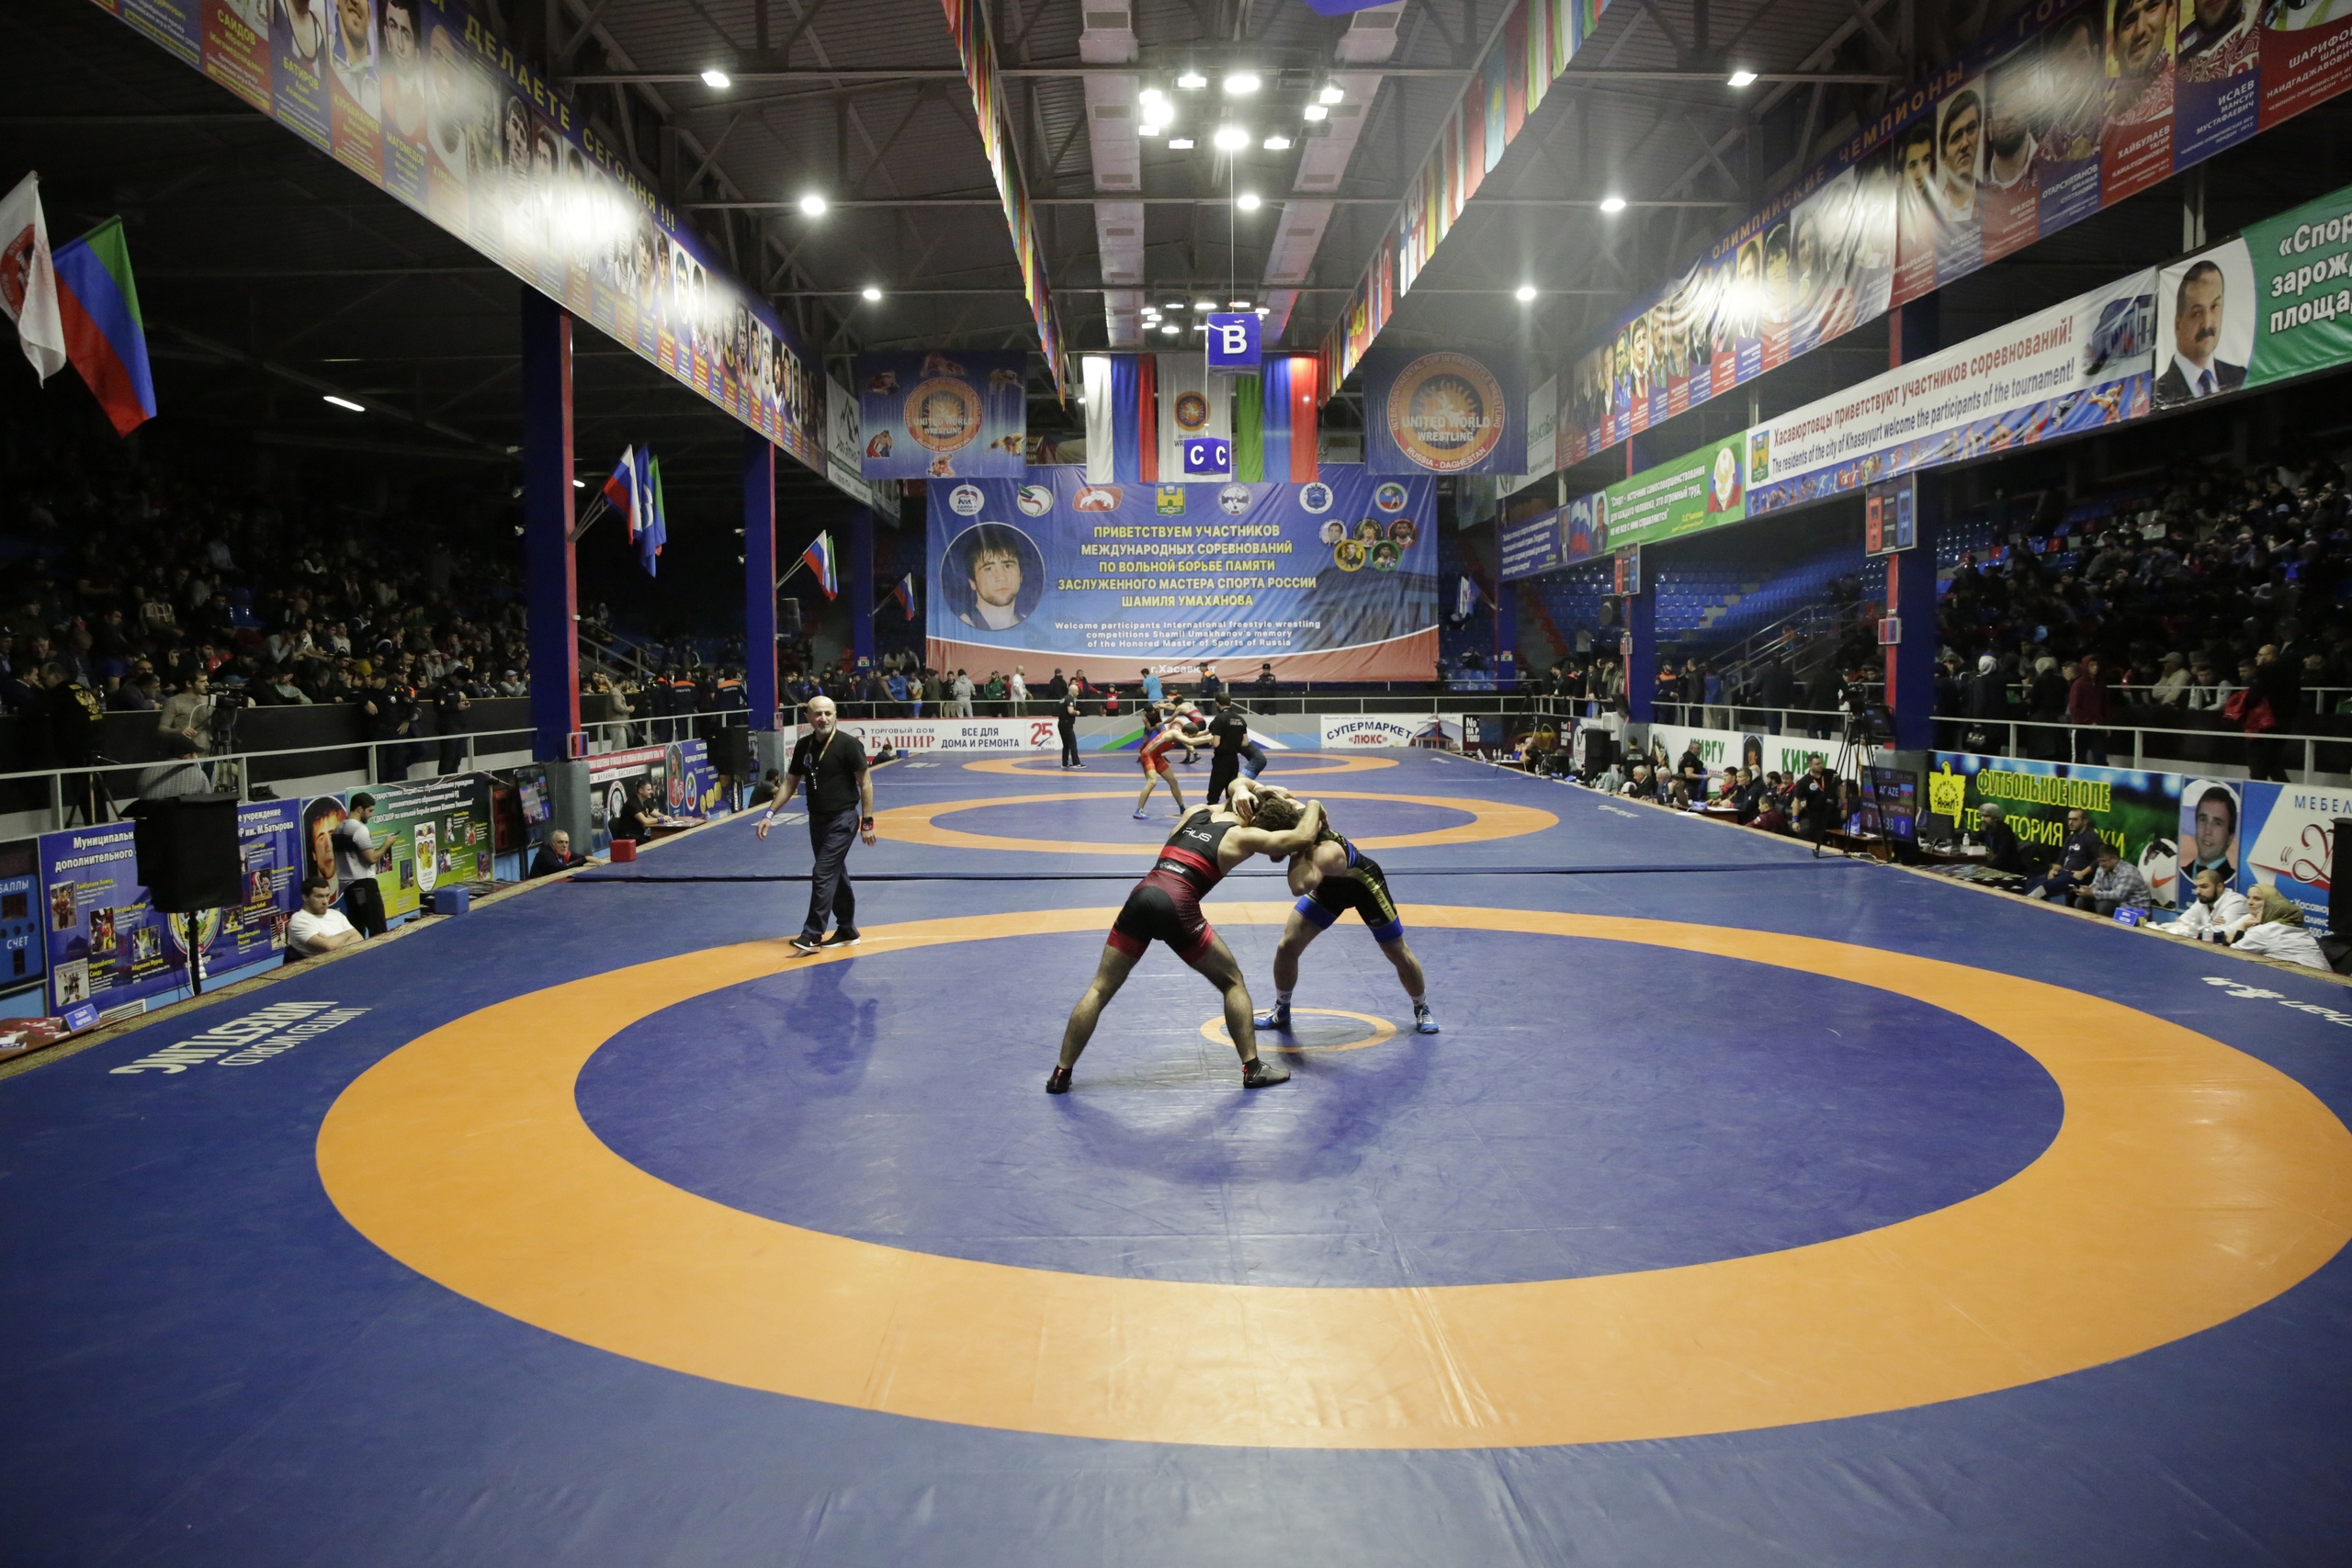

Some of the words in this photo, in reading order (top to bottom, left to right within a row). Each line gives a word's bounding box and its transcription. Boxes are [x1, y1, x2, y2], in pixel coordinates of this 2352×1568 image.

[218, 9, 256, 46] САИДОВ
[283, 56, 319, 90] БАТИРОВ
[2218, 79, 2255, 106] ИСАЕВ
[2221, 91, 2255, 114] МАНСУР
[465, 14, 571, 131] ДЕЛАЕТЕ
[582, 128, 656, 213] СЕГОДНЯ
[2197, 100, 2255, 135] МУСТАФАЕВИЧ
[2118, 125, 2170, 159] ХАЙБУЛАЕВ
[2150, 135, 2170, 151] ТАГИР
[1712, 166, 1825, 260] ОЛИМПИЙСКИЕ
[1838, 61, 1963, 163] ЧЕМПИОНЫ
[2009, 197, 2036, 216] МАХОВ
[1773, 411, 1833, 447] Хасавюртовцы
[1834, 385, 1899, 429] приветствуют
[1902, 362, 1967, 406] участников
[1970, 315, 2073, 378] соревнований!
[1389, 363, 1424, 431] INTERCONTINENTAL
[1423, 355, 1441, 367] CUP
[1452, 355, 1490, 385] FREESTYLE
[1487, 380, 1501, 430] WRESTLING
[914, 417, 943, 426] UNITED
[944, 417, 974, 426] WORLD
[1401, 416, 1446, 428] UNITED
[1449, 416, 1490, 428] WORLD
[1772, 457, 1782, 474] The
[1782, 449, 1808, 468] residents
[1808, 446, 1815, 461] of
[1815, 444, 1825, 459] the
[1826, 440, 1837, 459] city
[1838, 434, 1845, 452] of
[1845, 423, 1883, 452] Khasavyurt
[1883, 416, 1916, 438] welcome
[1917, 408, 1930, 428] the
[1930, 391, 1981, 429] participants
[1983, 383, 1993, 405] of
[1994, 381, 2009, 404] the
[2011, 356, 2075, 396] tournament!
[924, 427, 962, 435] WRESTLING
[1417, 432, 1475, 442] WRESTLING
[916, 437, 935, 451] RUSSIA
[939, 437, 971, 452] DAGHESTAN
[1406, 446, 1434, 468] RUSSIA
[1440, 447, 1487, 469] DAGHESTAN
[1093, 525, 1192, 538] ПРИВЕТСТВУЕМ
[1195, 525, 1280, 537] УЧАСТНИКОВ
[1081, 543, 1194, 557] МЕЖДУНАРОДНЫХ
[1197, 540, 1293, 555] СОРЕВНОВАНИЙ
[1099, 561, 1115, 572] ПО
[1119, 559, 1175, 572] ВОЛЬНОЙ
[1178, 559, 1222, 572] БОРЬБЕ
[1225, 559, 1275, 571] ПАМЯТИ
[1058, 578, 1156, 591] ЗАСЛУЖЕННОГО
[1159, 577, 1215, 590] МАСТЕРА
[1217, 577, 1264, 590] СПОРТА
[1267, 576, 1317, 589] РОССИИ
[1121, 594, 1175, 607] ШАМИЛЯ
[1178, 594, 1253, 606] УМАХАНОВА
[1055, 621, 1098, 630] Welcome
[1101, 621, 1160, 631] participants
[1163, 621, 1227, 629] International
[1229, 620, 1272, 630] freestyle
[1275, 620, 1321, 629] wrestling
[1086, 630, 1149, 640] competitions
[1188, 629, 1250, 637] Umakhanov's
[1254, 630, 1293, 638] memory
[1088, 639, 1098, 648] of
[1100, 639, 1116, 648] the
[1119, 639, 1159, 648] Honored
[1162, 638, 1197, 647] Master
[1199, 638, 1210, 647] of
[1212, 638, 1244, 648] Sports
[1246, 638, 1257, 647] of
[1259, 637, 1292, 647] Russia
[961, 728, 978, 737] ВСЕ
[979, 728, 999, 738] ДЛЯ
[1030, 722, 1054, 747] 25
[1327, 721, 1413, 740] СУПЕРМАРКЕТ
[871, 735, 935, 749] БАШИР
[942, 739, 967, 750] ДОМА
[970, 739, 976, 748] И
[977, 738, 1020, 748] РЕМОНТА
[1349, 734, 1387, 745] «ЛЮКС»
[1976, 768, 2068, 807] ФУТБОЛЬНОЕ
[2068, 780, 2111, 813] ПОЛЕ
[243, 807, 281, 823] учреждение
[244, 828, 256, 837] им.
[257, 820, 294, 835] М.Батырова
[1182, 826, 1213, 843] RUS
[74, 830, 134, 851] Муниципальн
[55, 848, 133, 873] дополнительного
[6, 935, 28, 950] СЧЕТ
[287, 1008, 372, 1034] UNITED
[108, 1001, 339, 1075] WRESTLING
[217, 1035, 317, 1066] WORLD
